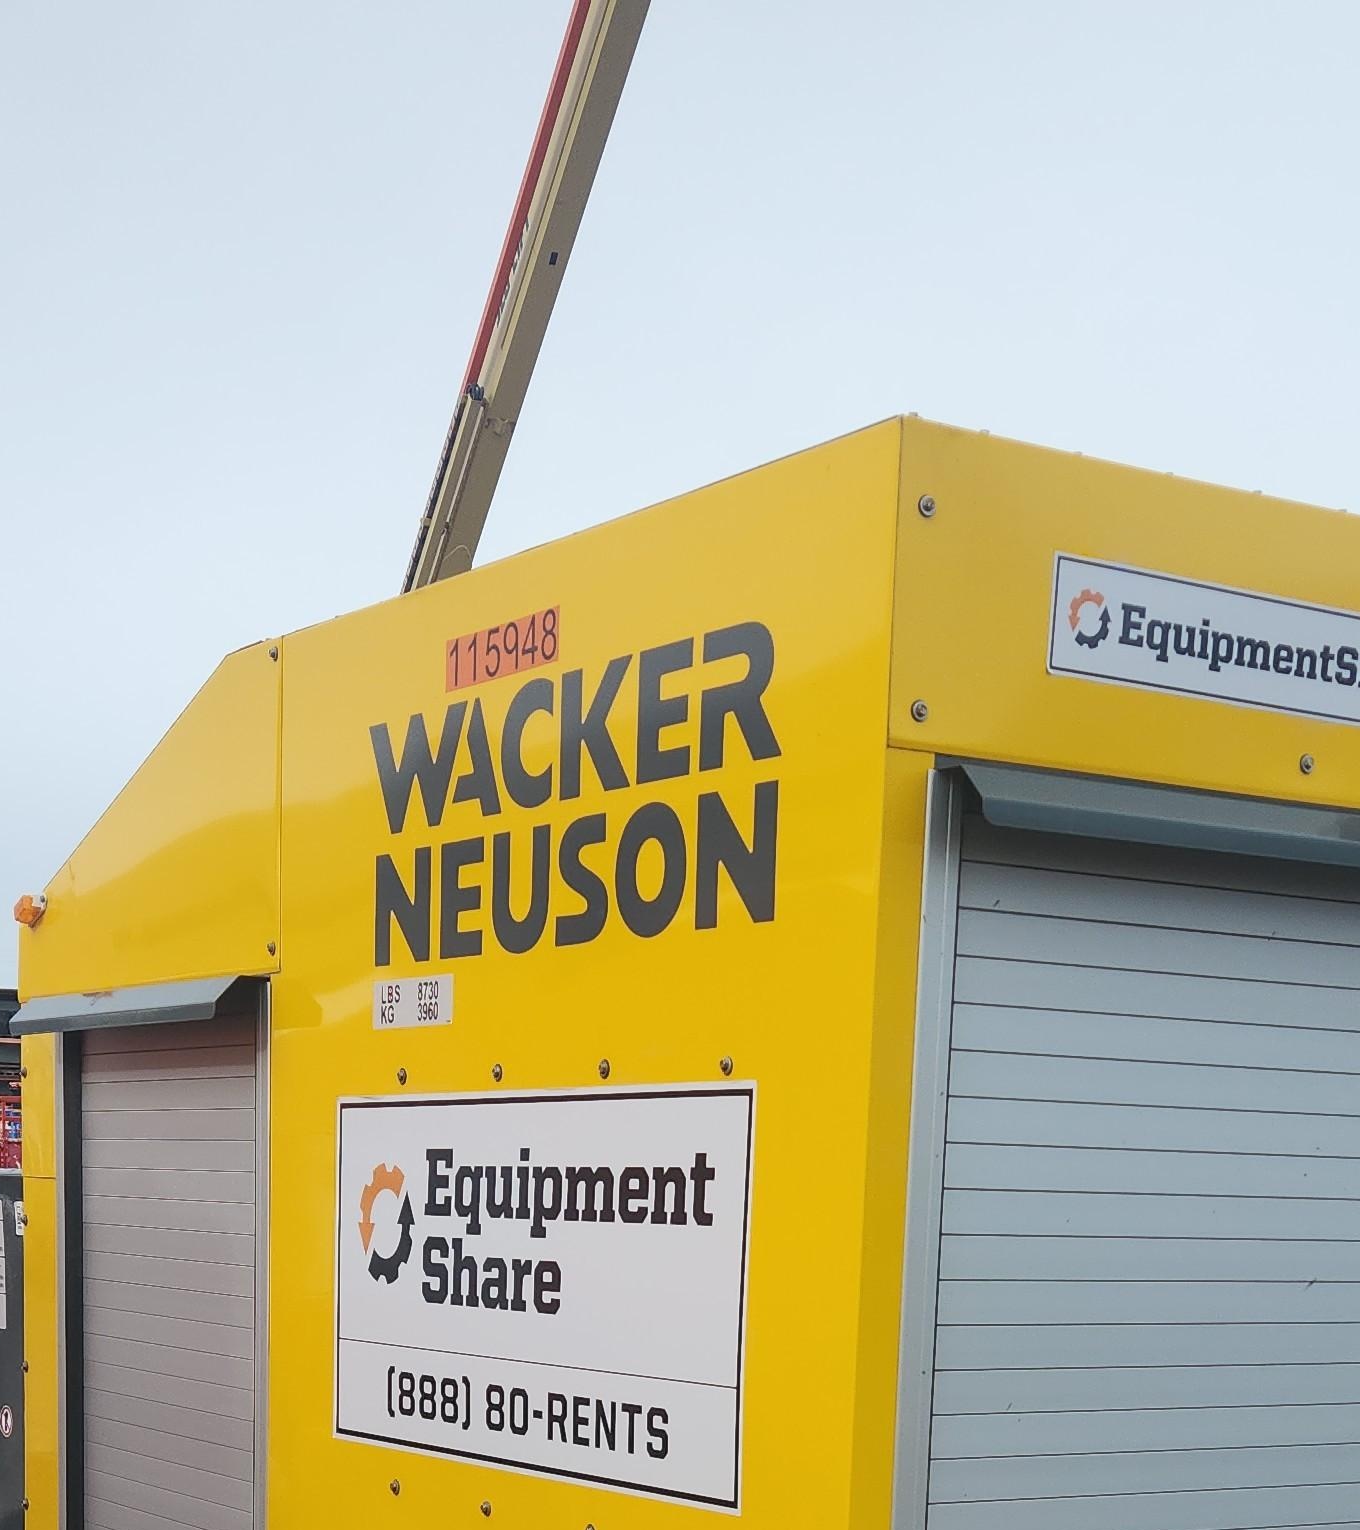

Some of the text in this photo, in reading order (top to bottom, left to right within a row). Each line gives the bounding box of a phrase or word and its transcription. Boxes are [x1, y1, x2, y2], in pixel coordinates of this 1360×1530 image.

[448, 606, 558, 687] 115948
[368, 621, 781, 834] WACKER
[373, 780, 779, 967] NEUSON
[380, 1002, 439, 1024] KG 3960
[381, 980, 439, 1004] LBS 8730
[423, 1148, 715, 1238] Equipment
[422, 1237, 561, 1314] Share
[387, 1365, 669, 1459] (888) 80-RENTS
